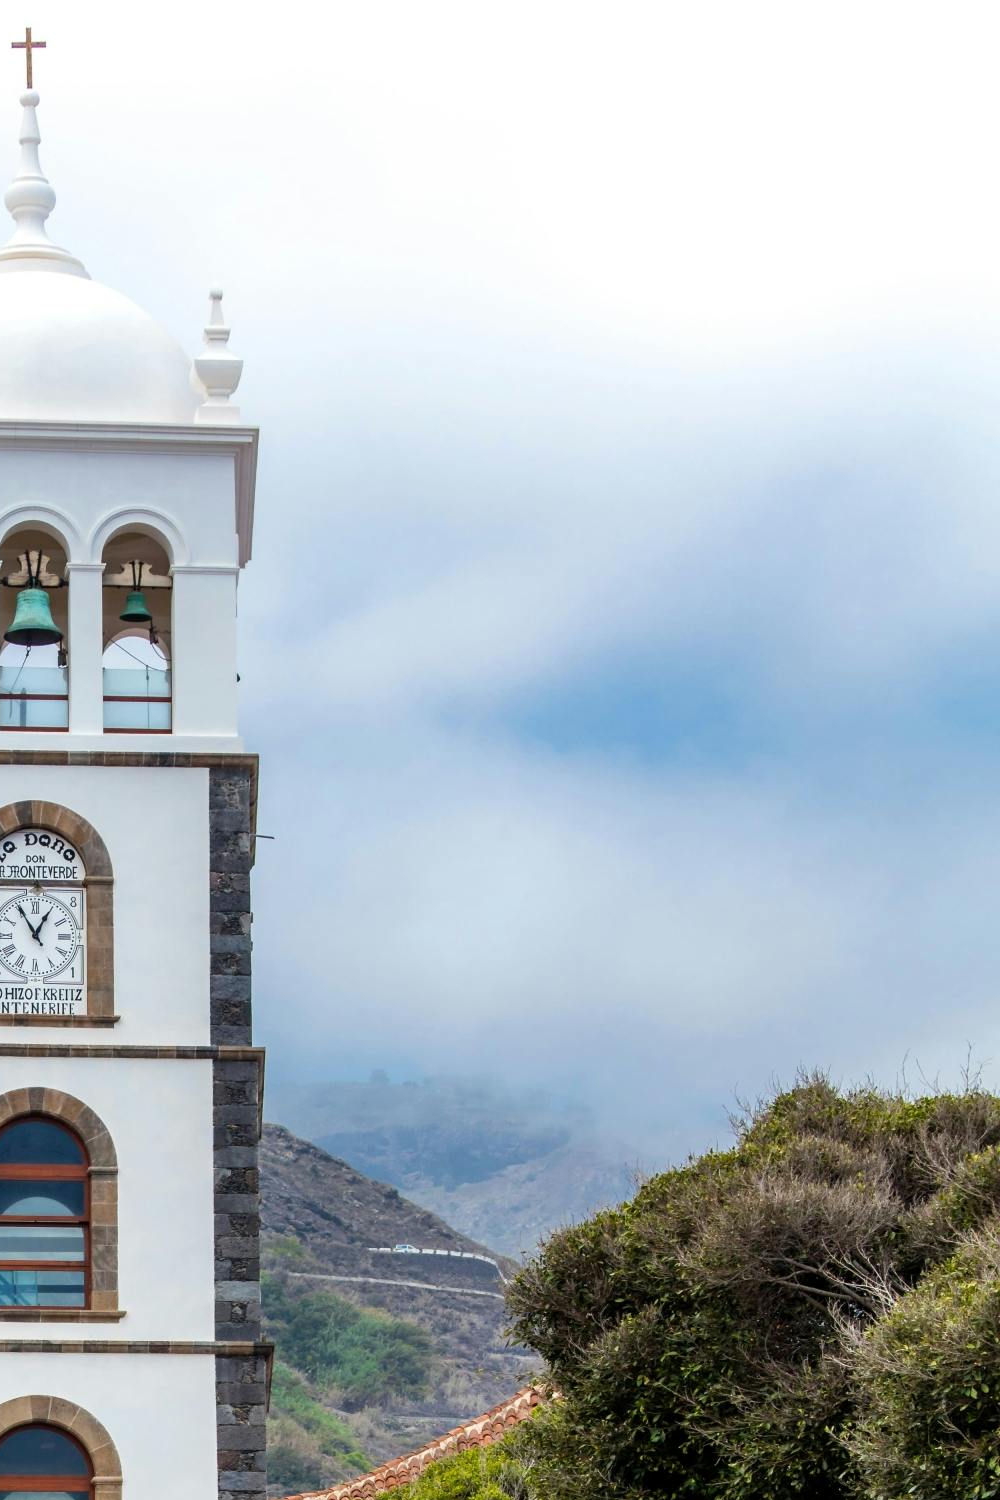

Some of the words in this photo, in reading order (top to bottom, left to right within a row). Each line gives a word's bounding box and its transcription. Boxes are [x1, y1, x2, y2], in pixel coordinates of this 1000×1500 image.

[26, 855, 45, 863] DON
[31, 901, 40, 915] XII
[70, 896, 77, 908] 8
[5, 987, 33, 1000] HIZO
[11, 1002, 75, 1015] TENERIFE
